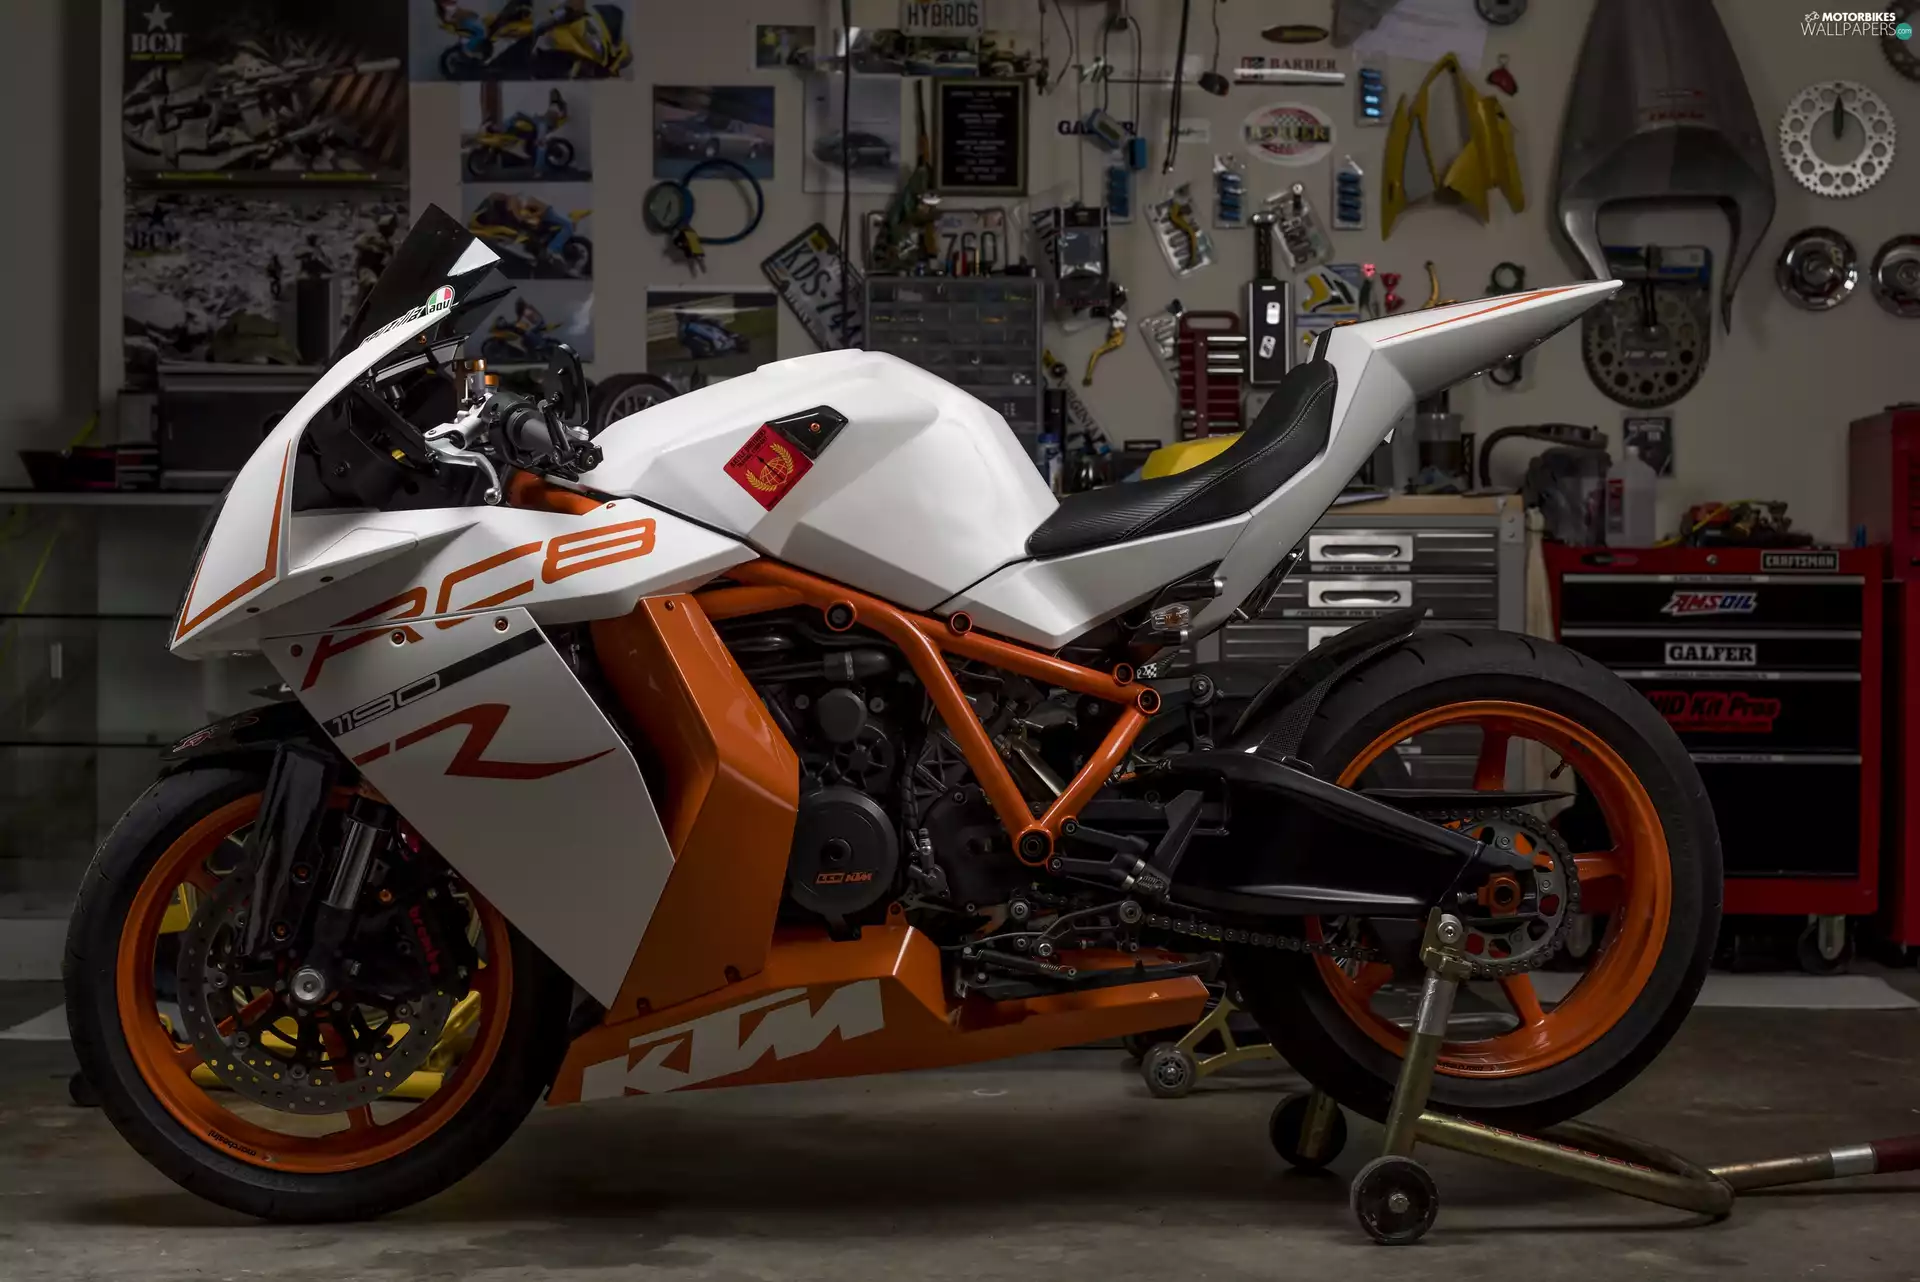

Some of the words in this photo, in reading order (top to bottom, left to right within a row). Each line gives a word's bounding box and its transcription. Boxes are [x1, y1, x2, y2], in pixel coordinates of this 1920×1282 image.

[131, 32, 184, 53] BCM
[1764, 554, 1836, 569] CRAFTSMAN
[1664, 591, 1757, 614] AMSOIL
[1669, 645, 1753, 663] GALFER
[332, 672, 441, 735] 1190
[580, 978, 886, 1102] KTM
[207, 1130, 258, 1157] marchesini
